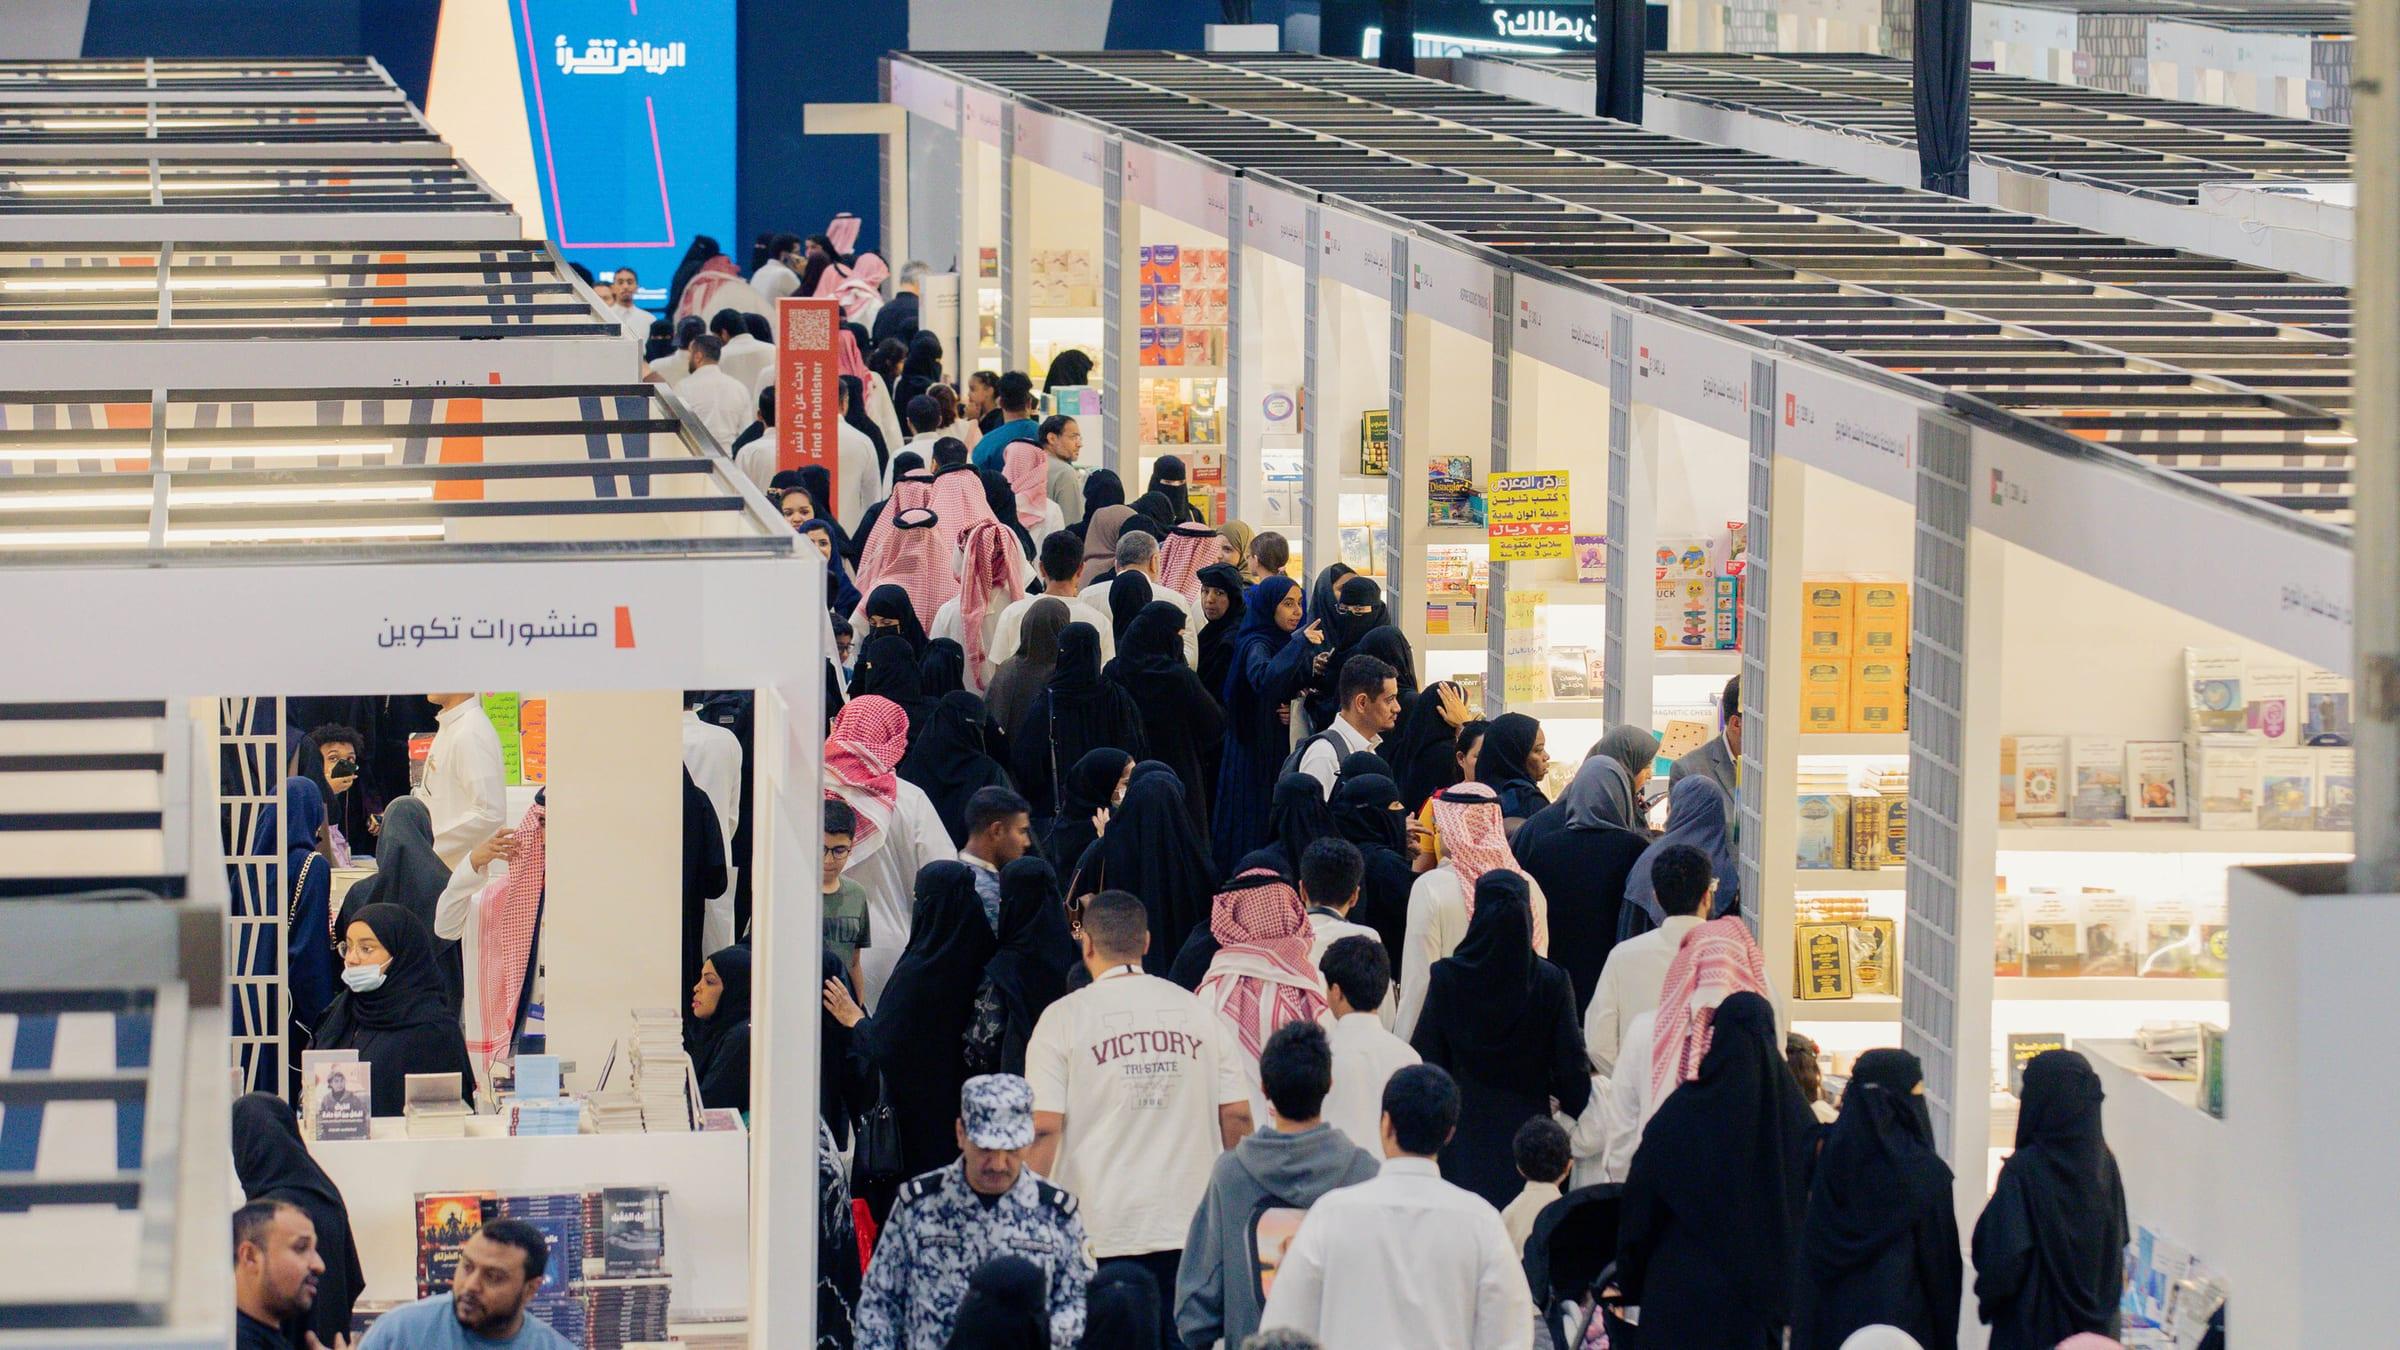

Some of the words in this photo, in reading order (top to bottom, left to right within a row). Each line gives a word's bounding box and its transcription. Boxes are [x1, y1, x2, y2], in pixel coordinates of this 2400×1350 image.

[1493, 9, 1582, 42] بطلك؟
[554, 34, 618, 75] تقرأ
[573, 38, 686, 75] الرياض
[791, 362, 807, 390] ابحث
[792, 392, 807, 410] عن
[811, 362, 823, 420] Publisher
[793, 413, 807, 428] دار
[813, 421, 823, 430] a
[790, 431, 807, 454] نشر
[812, 433, 823, 458] Find
[1491, 476, 1535, 491] المعرض
[1537, 475, 1567, 490] عرض
[1532, 493, 1558, 504] كتب
[1493, 524, 1527, 536] ريال
[1656, 590, 1676, 598] UCK
[378, 616, 462, 648] تكوين
[469, 610, 598, 647] منشورات
[1091, 1030, 1203, 1065] VICTORY
[1121, 1061, 1179, 1075] TRI-STATE
